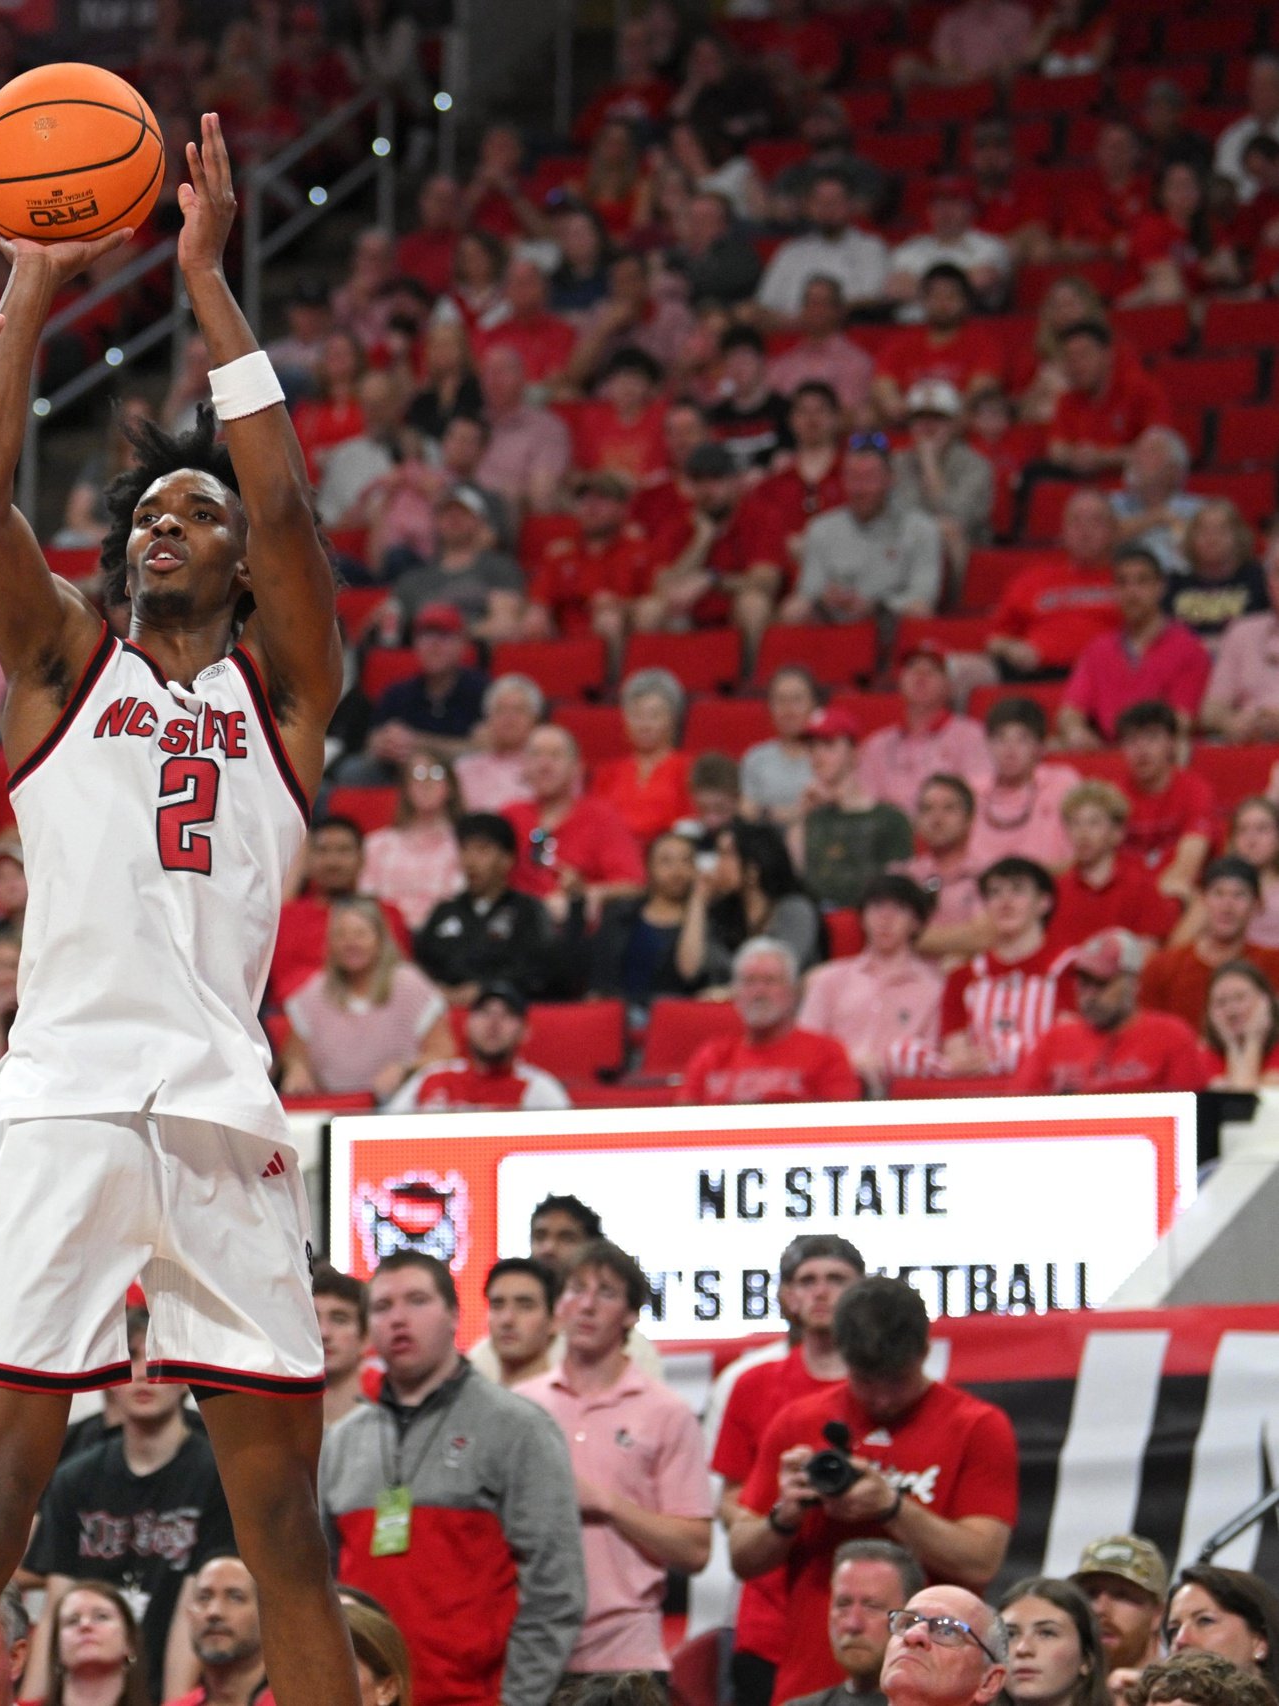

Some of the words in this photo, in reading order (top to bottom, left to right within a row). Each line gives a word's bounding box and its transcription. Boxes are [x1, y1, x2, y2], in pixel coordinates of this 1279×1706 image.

[29, 198, 99, 227] PRO
[93, 696, 159, 739] NC
[157, 702, 248, 759] SAE
[155, 756, 221, 877] 2
[698, 1168, 764, 1220] NC
[784, 1162, 948, 1217] STATE
[741, 1262, 1103, 1321] BTBALL
